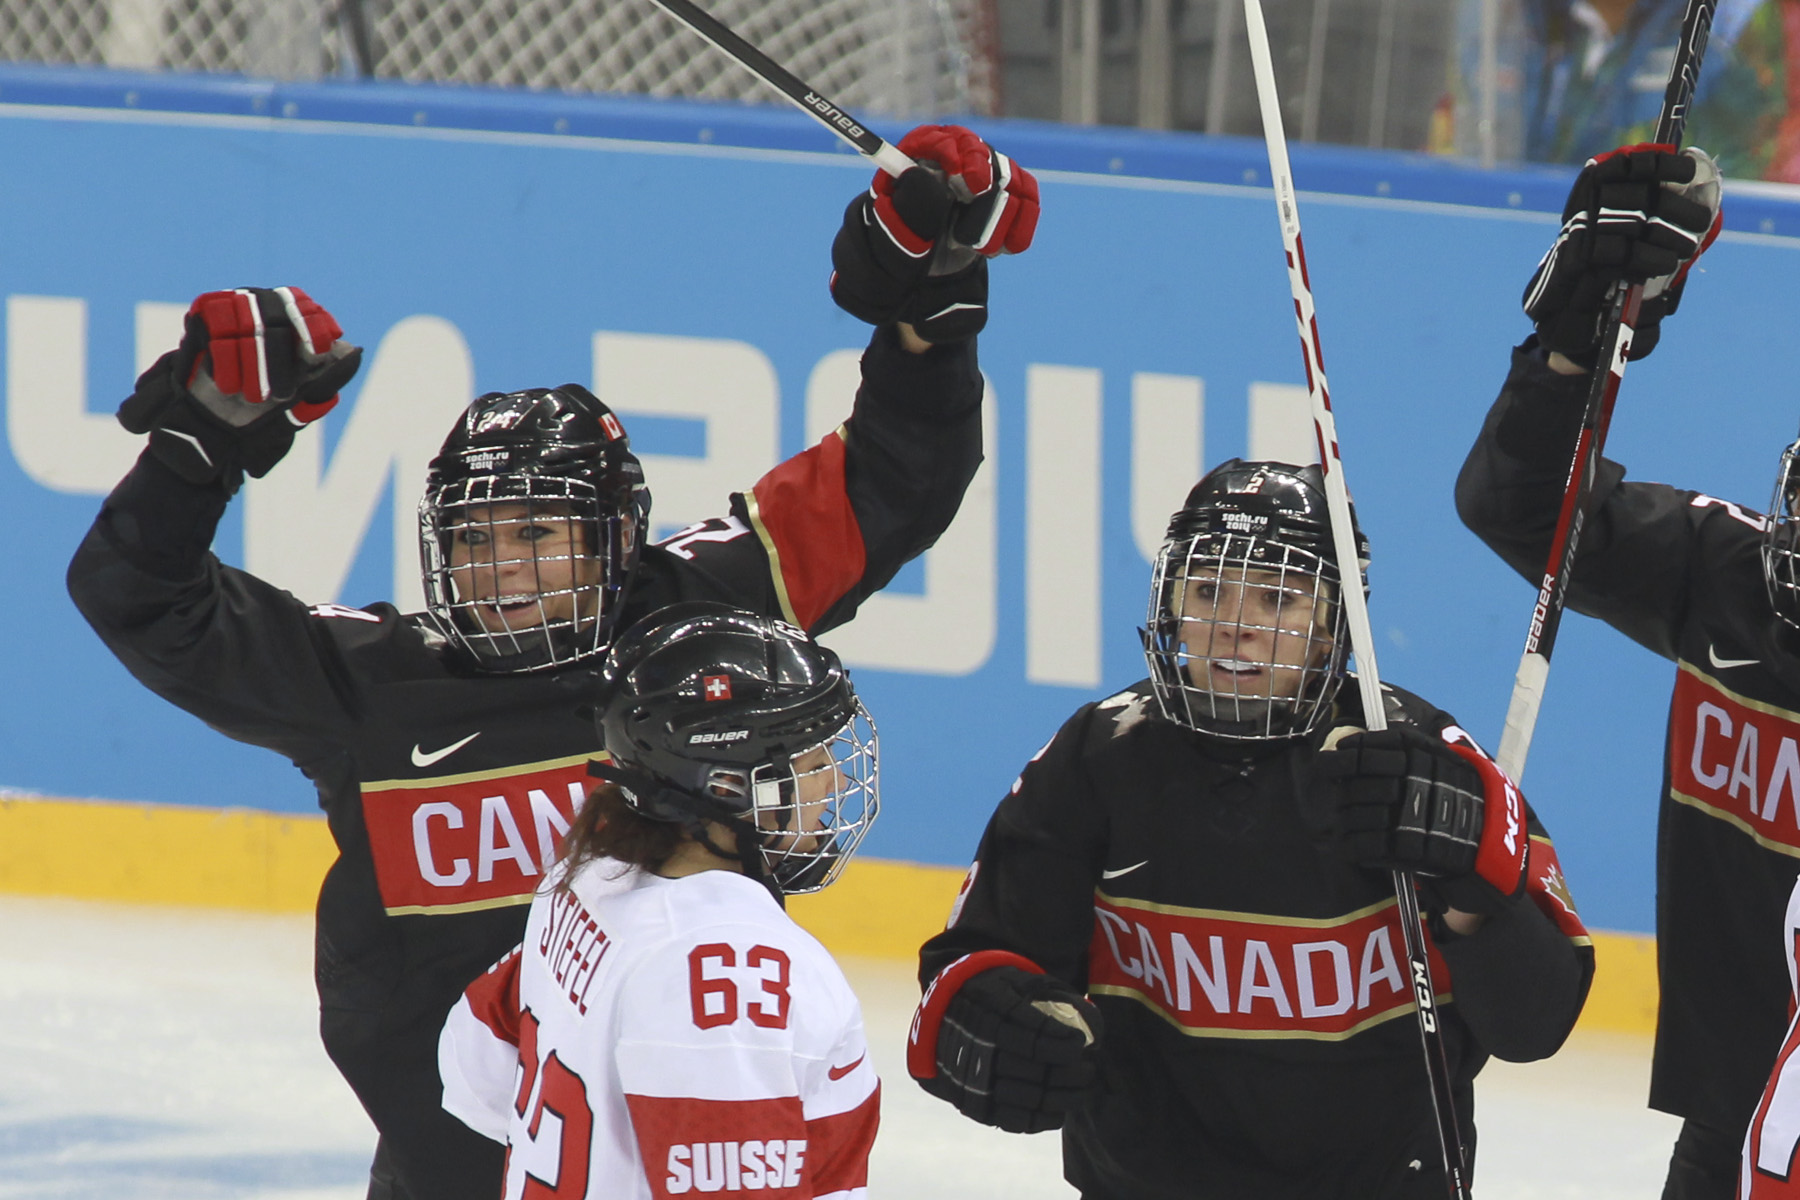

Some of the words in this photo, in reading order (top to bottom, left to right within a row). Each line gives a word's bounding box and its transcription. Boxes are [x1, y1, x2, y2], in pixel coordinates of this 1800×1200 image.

[803, 91, 865, 138] BAUER
[465, 451, 509, 464] sochi.ru
[470, 461, 493, 470] 2014
[1221, 512, 1268, 525] sochi.ru
[1226, 521, 1251, 533] 2014
[1555, 508, 1584, 611] BAUER
[1527, 573, 1555, 653] BAUER
[689, 729, 749, 744] BAUER
[688, 943, 791, 1030] 63
[1094, 905, 1404, 1018] CANADA
[1412, 960, 1437, 1034] CCM
[666, 1139, 807, 1194] SUISSE
